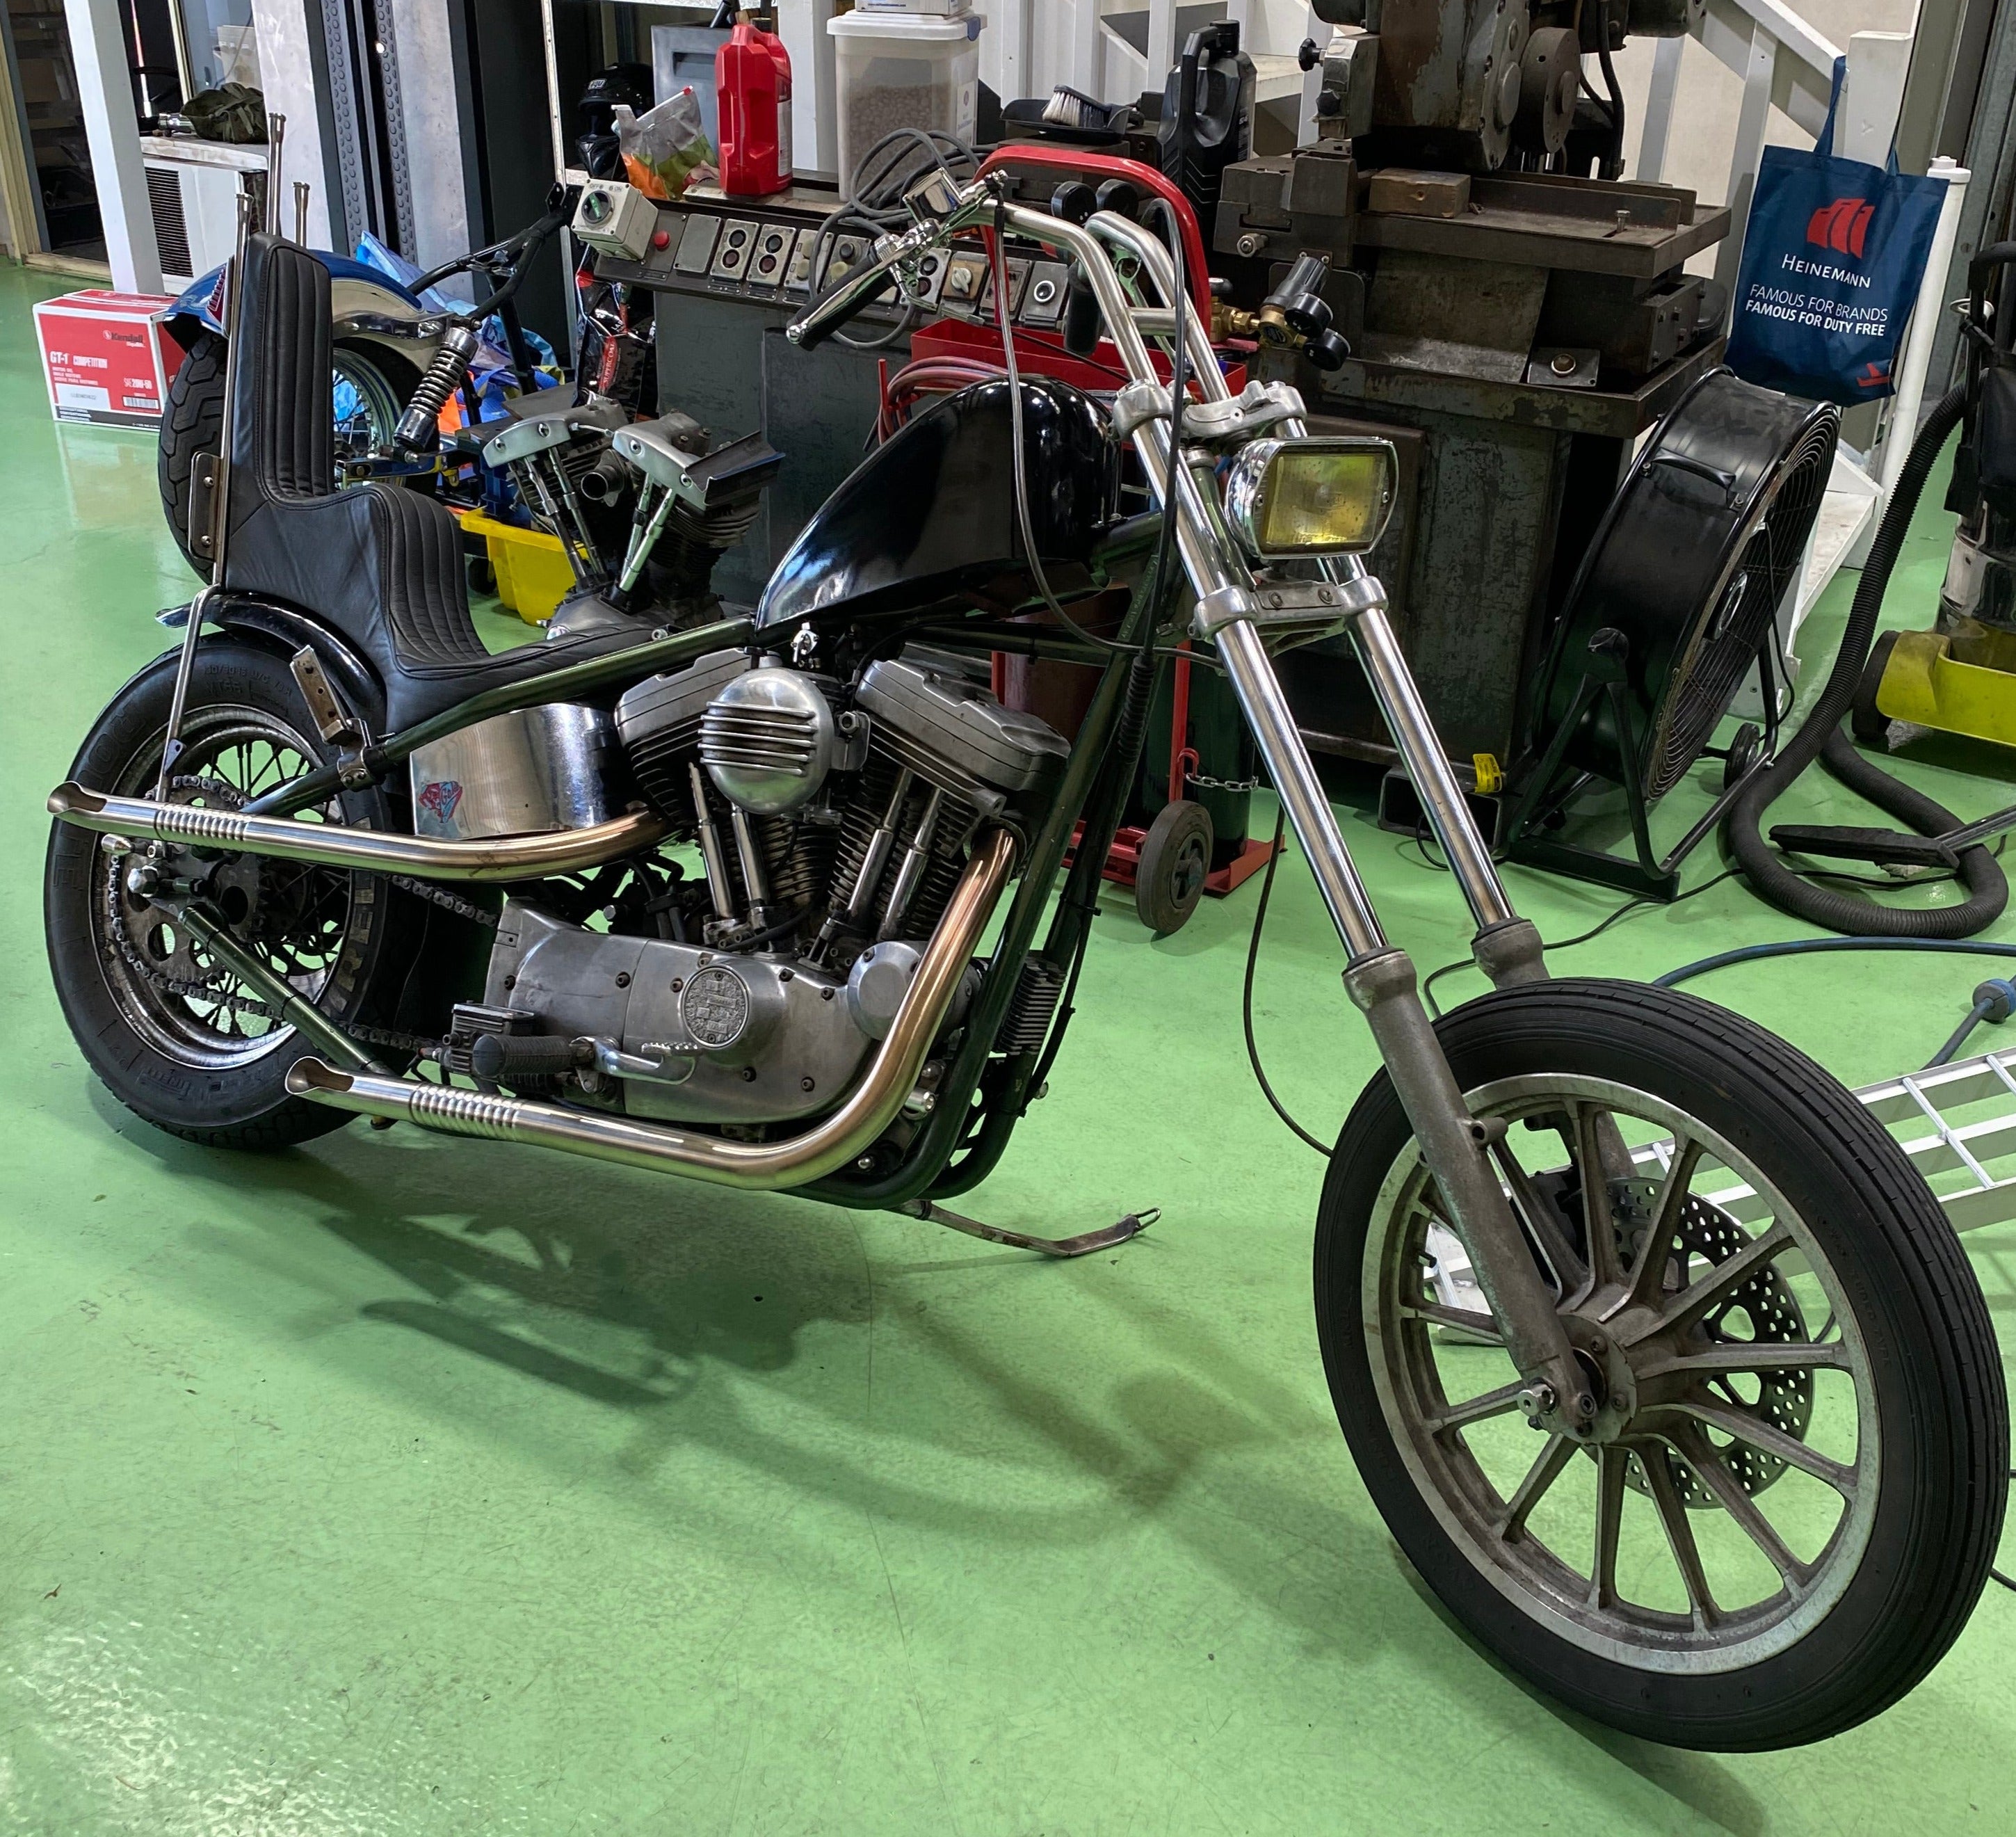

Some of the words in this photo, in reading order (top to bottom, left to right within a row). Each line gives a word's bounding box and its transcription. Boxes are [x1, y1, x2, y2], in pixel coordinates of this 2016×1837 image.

[1782, 253, 1871, 289] HEINEMANN
[1745, 299, 1798, 321] FAMOUS
[1798, 312, 1823, 328] FOR
[1823, 316, 1853, 335] DUTY
[1855, 323, 1887, 337] FREE
[1750, 284, 1806, 308] FAMOUS
[1808, 296, 1834, 314] FOR
[1836, 303, 1889, 322] BRANDS
[111, 332, 143, 342] Kendall
[50, 351, 69, 364] GT-1
